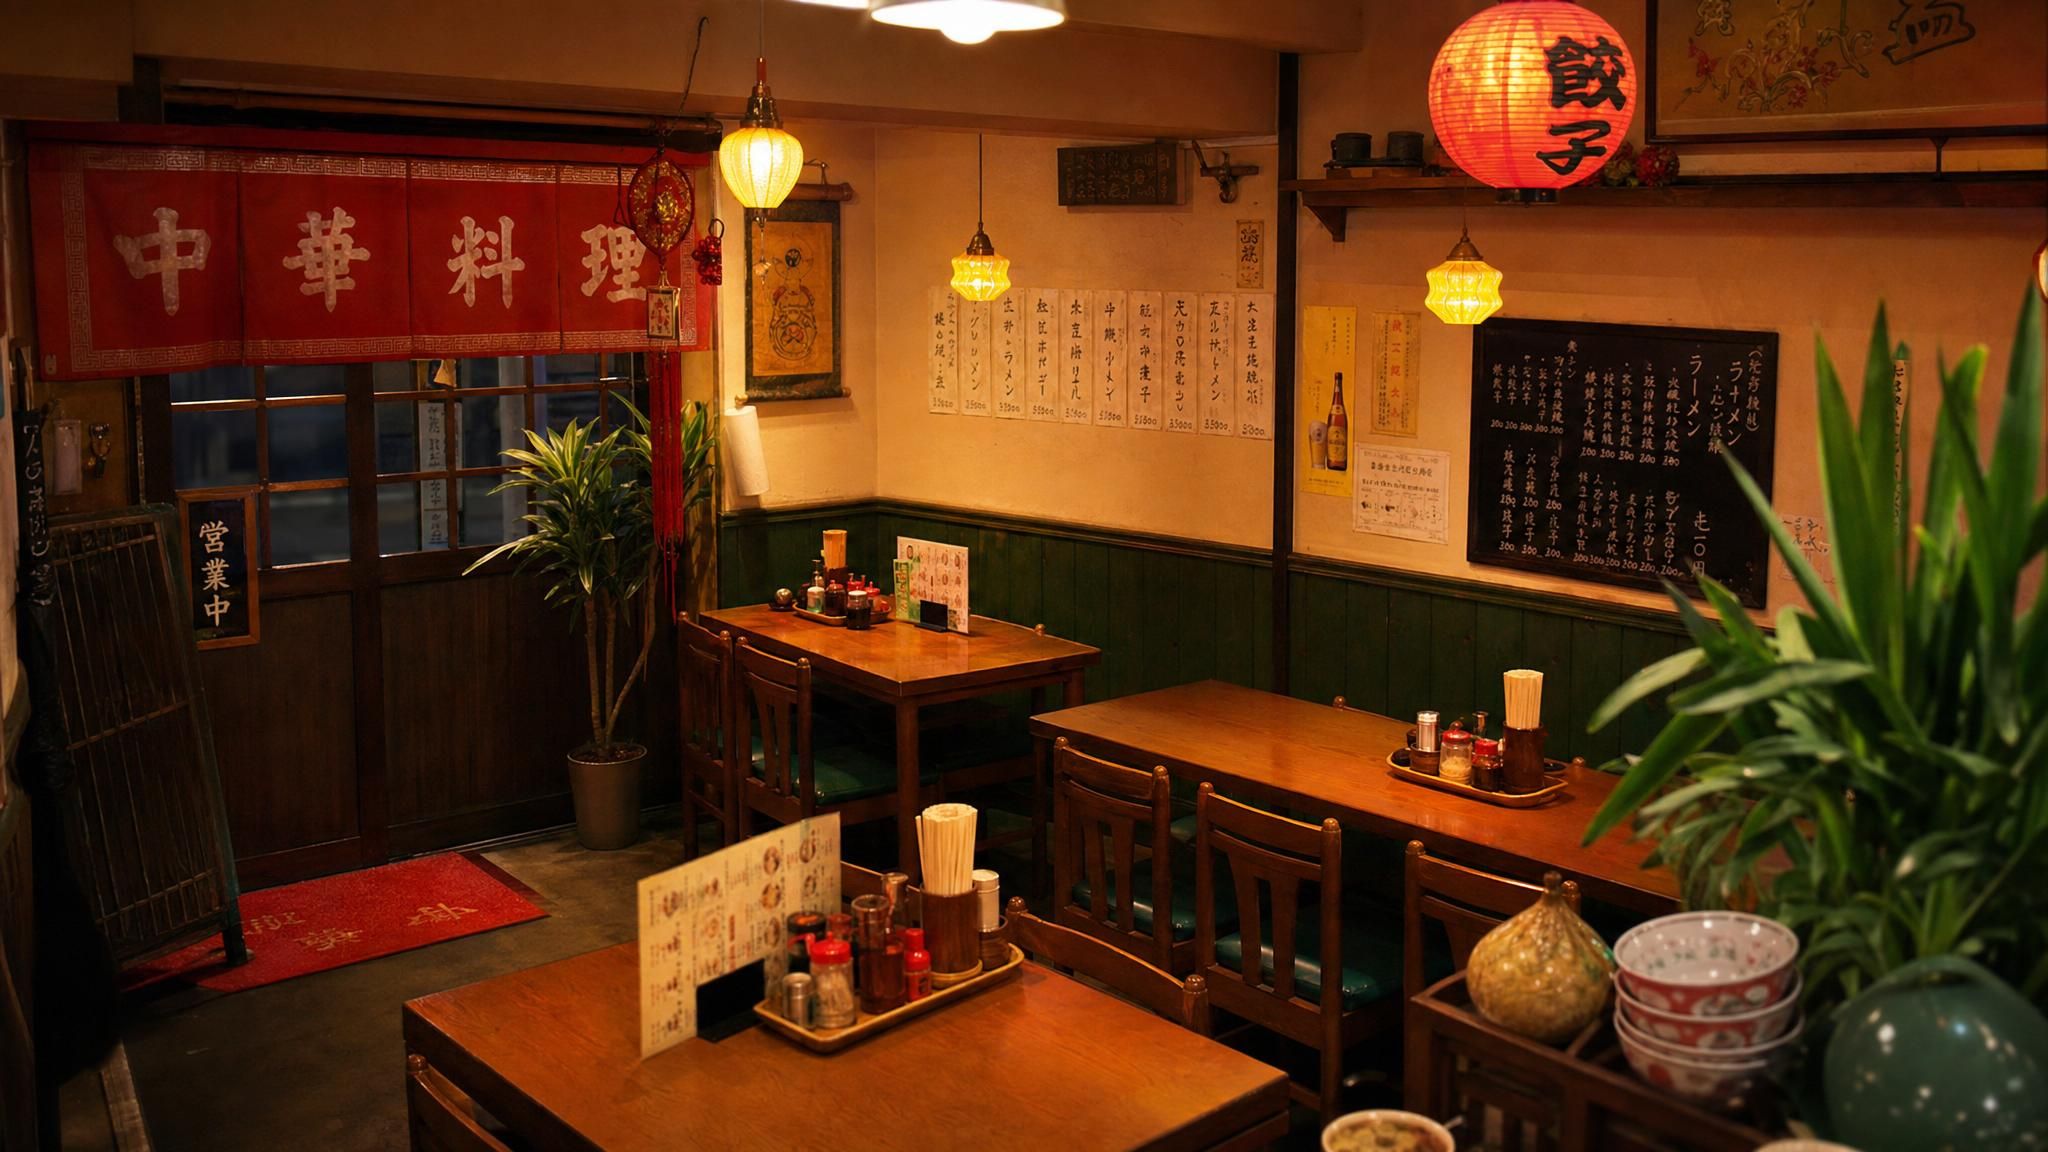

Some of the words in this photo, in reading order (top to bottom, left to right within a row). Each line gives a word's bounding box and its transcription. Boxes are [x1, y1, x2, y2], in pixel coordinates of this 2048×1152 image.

[1537, 35, 1627, 177] 餃子
[113, 206, 647, 316] 中華料理
[1687, 355, 1702, 437] ラーメン
[199, 519, 231, 628] 営業中
